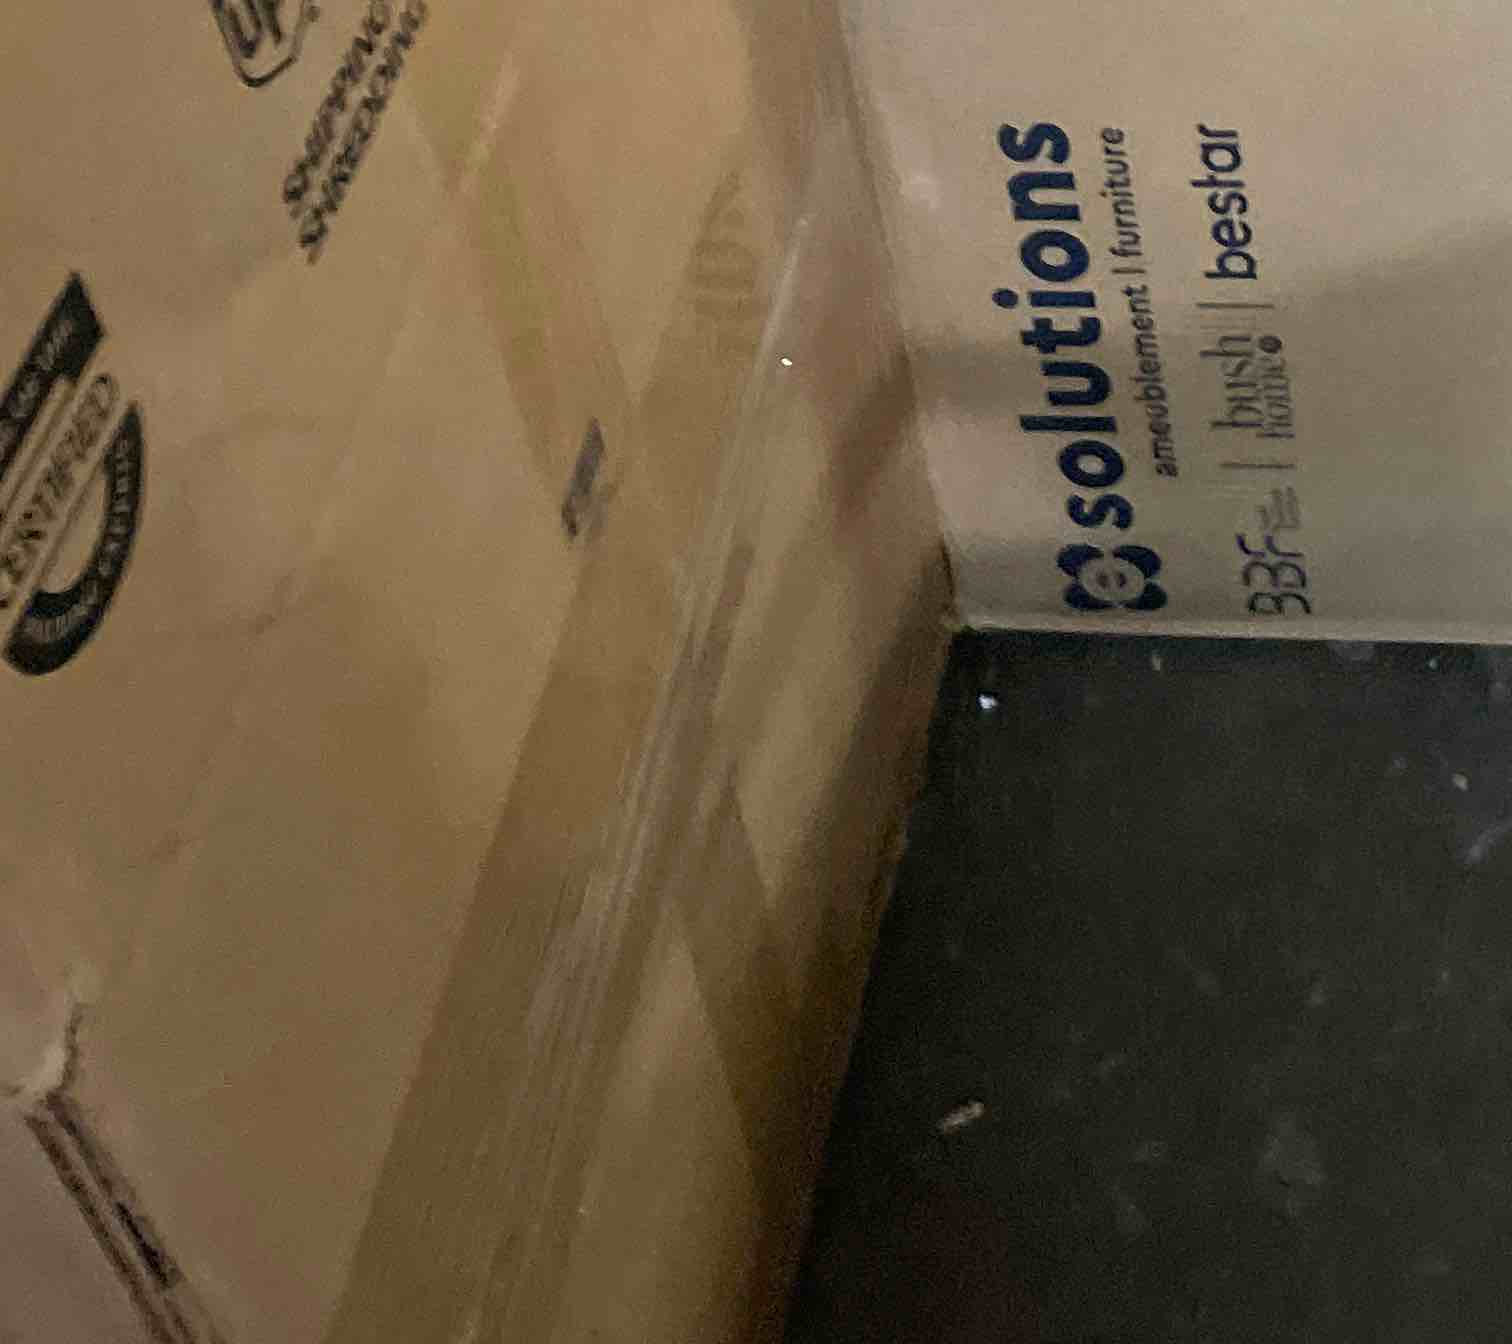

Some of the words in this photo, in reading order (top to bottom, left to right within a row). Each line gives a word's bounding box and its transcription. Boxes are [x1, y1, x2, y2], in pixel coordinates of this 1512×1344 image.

[1101, 126, 1144, 258] furniture
[1191, 122, 1259, 281] bestar
[993, 123, 1134, 529] solutions
[1123, 284, 1179, 479] ameublement
[1200, 334, 1264, 431] bush
[1257, 356, 1295, 439] home
